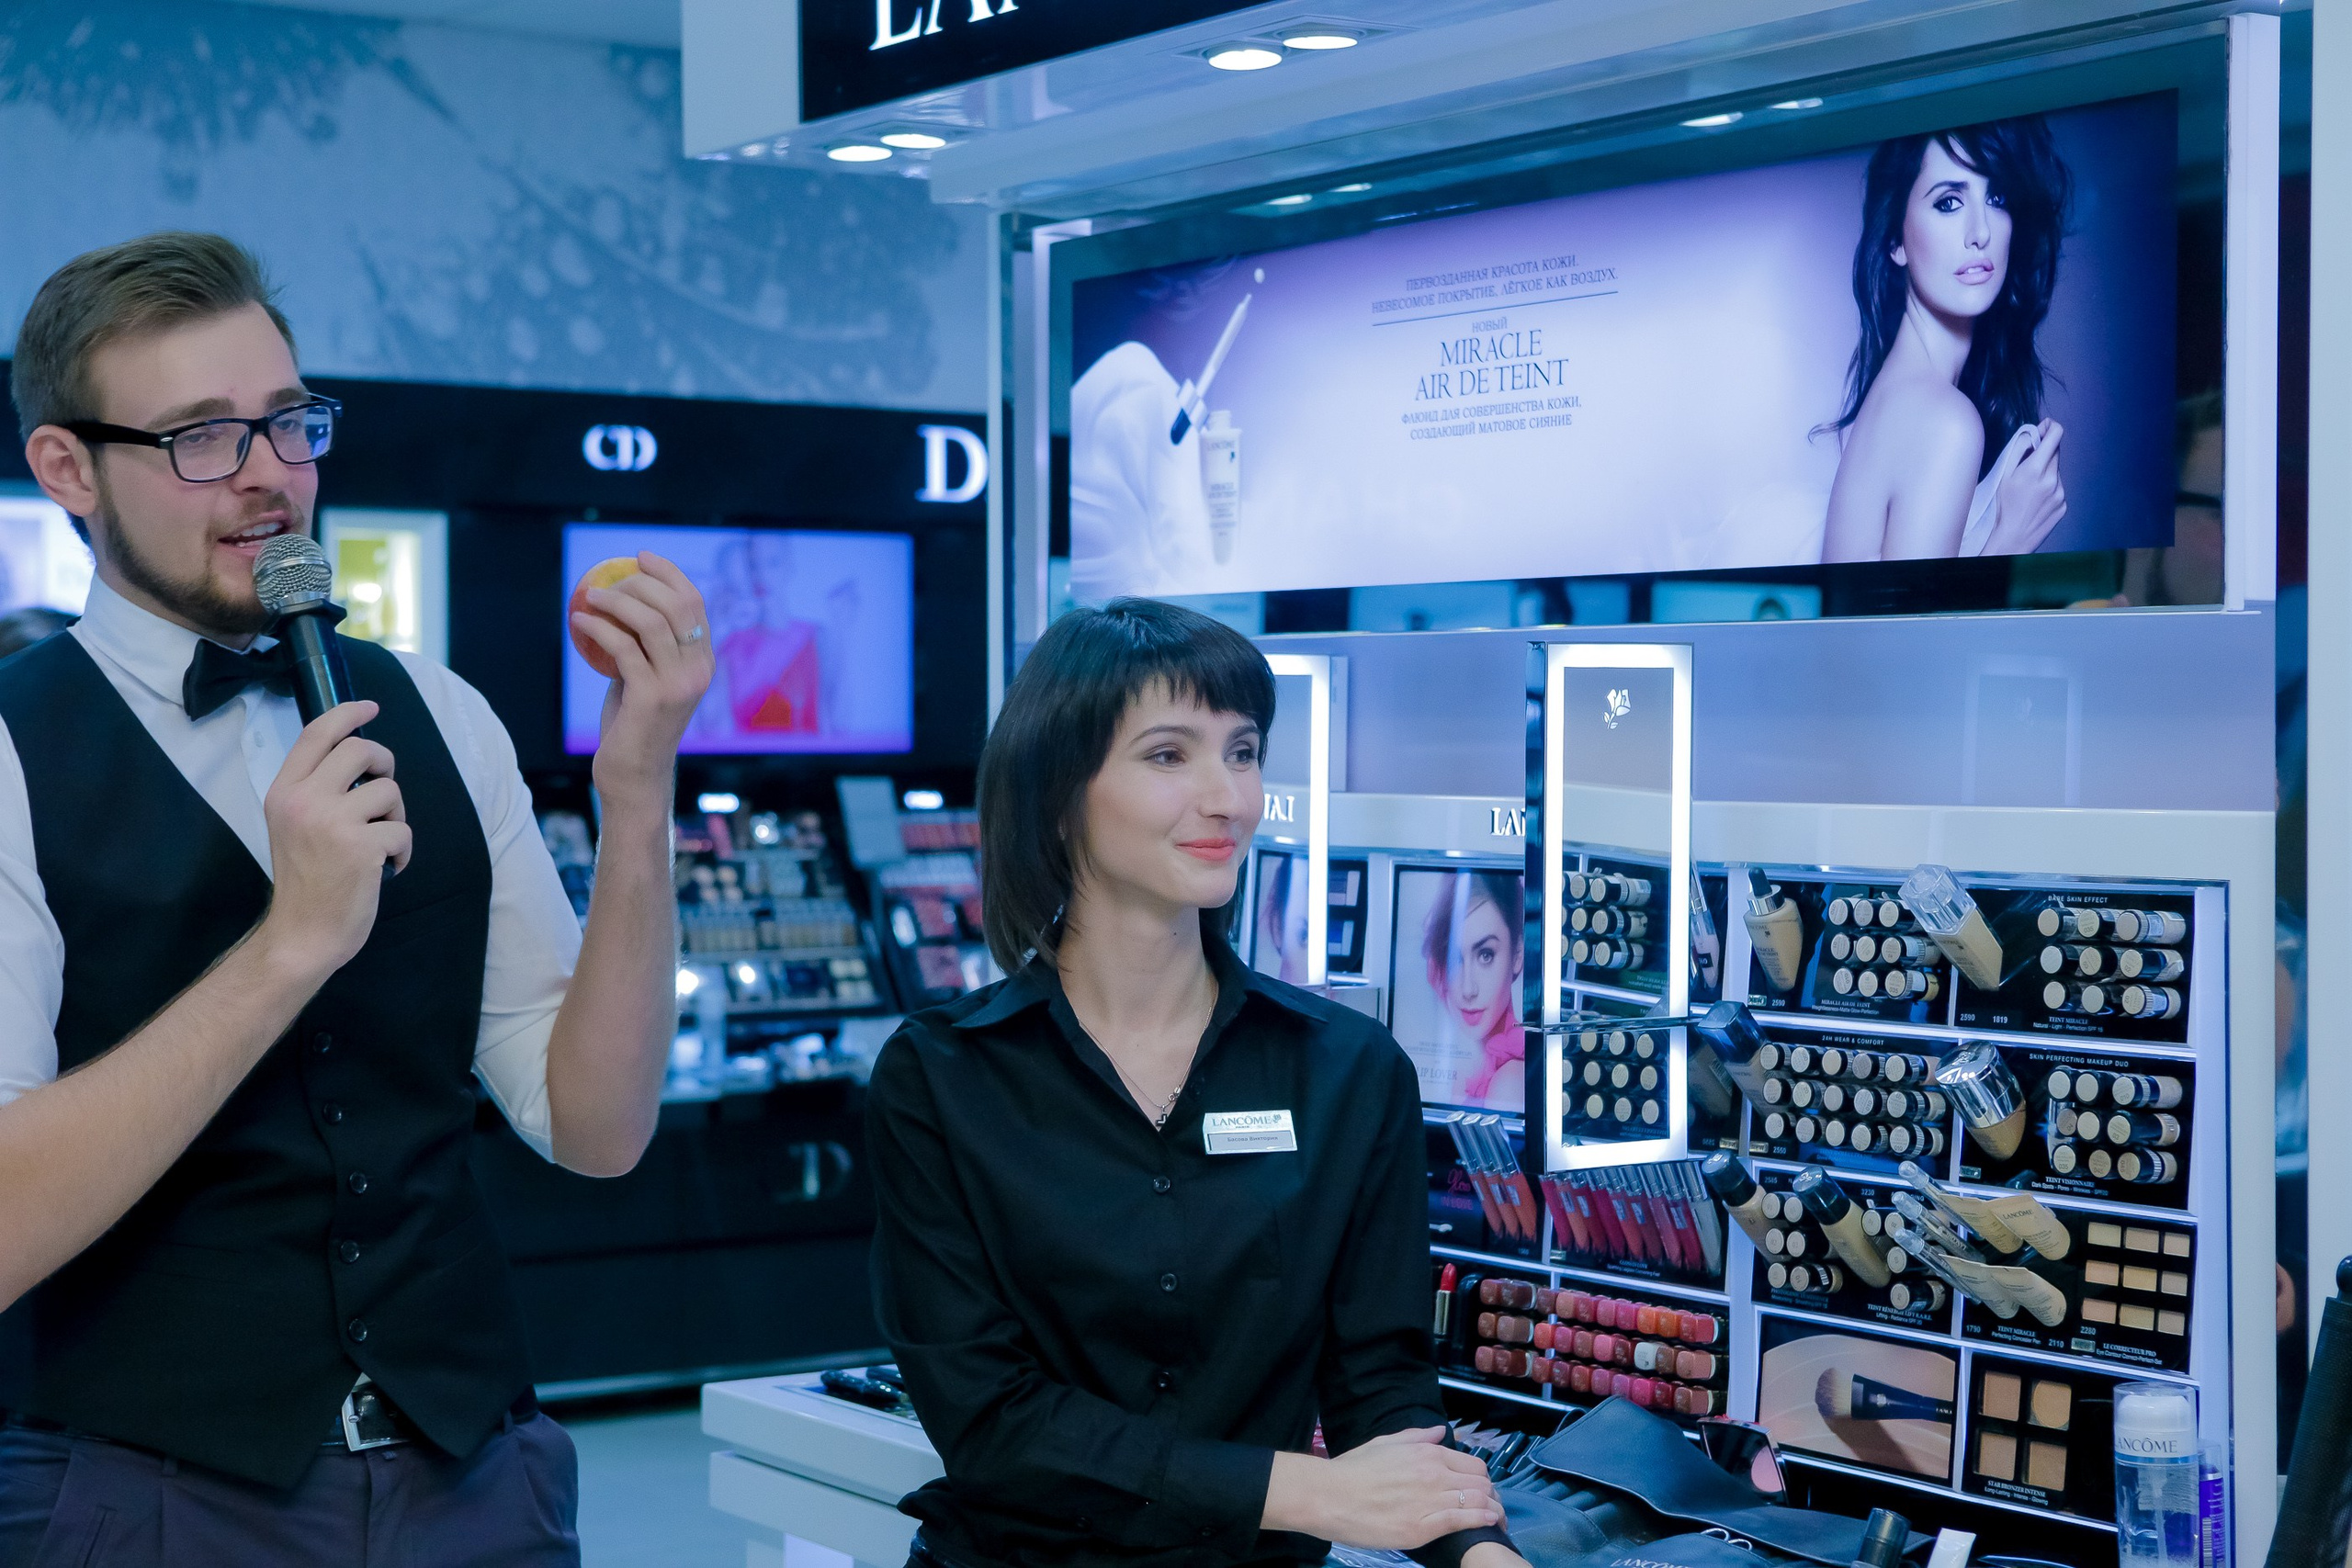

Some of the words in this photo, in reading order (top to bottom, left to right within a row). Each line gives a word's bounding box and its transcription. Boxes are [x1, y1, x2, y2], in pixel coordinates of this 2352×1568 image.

[1407, 268, 1488, 291] ПЕРВОЗДАННАЯ
[1491, 261, 1539, 278] КРАСОТА
[1542, 254, 1579, 271] КОЖИ.
[1371, 293, 1435, 314] НЕВЕСОМОЕ
[1437, 286, 1498, 305] ПОКРЫТИЕ,
[1501, 278, 1543, 296] ЛЁГКОЕ
[1545, 275, 1567, 288] КАК
[1570, 267, 1619, 286] ВОЗДУХ.
[1472, 316, 1508, 333] НОВЫЙ
[1441, 329, 1543, 367] MIRACLE
[1415, 371, 1453, 400] AIR
[1459, 367, 1490, 396] DE
[1493, 358, 1569, 393] TEINT
[1401, 410, 1439, 424] ФЛЮИД
[1440, 407, 1461, 421] ДЛЯ
[1462, 399, 1544, 419] СОВЕРШЕНСТВА
[1546, 395, 1582, 410] КОЖИ,
[1409, 421, 1476, 441] СОЗДАЮЩИЙ
[1477, 419, 1526, 434] МАТОВОЕ
[1528, 414, 1573, 430] СИЯНИЕ
[1771, 998, 1786, 1007] 2590
[1960, 1013, 1975, 1021] 2590
[1992, 1015, 2008, 1024] 1819
[2065, 1017, 2088, 1025] MIRACLE
[1834, 1035, 1850, 1043] WEAR
[1857, 1038, 1884, 1046] COMFORT
[2029, 1053, 2045, 1061] SKIN
[2045, 1054, 2085, 1064] PERFECTING
[2086, 1056, 2113, 1066] MAKEUP
[2114, 1060, 2130, 1068] DUO
[1430, 1067, 1458, 1081] LOVER
[1212, 1115, 1272, 1127] LANCÔME
[1773, 1145, 1787, 1155] 2550
[2041, 1182, 2054, 1190] Spots
[2045, 1176, 2062, 1184] TEINT
[2061, 1179, 2096, 1188] VISIONNAIRE
[1867, 1303, 1882, 1312] TEINT
[1875, 1312, 1888, 1320] Lifting
[1890, 1314, 1908, 1323] Radiance
[1966, 1324, 1982, 1334] 1790
[1997, 1325, 2013, 1333] TEINT
[2013, 1327, 2036, 1337] MIRACLE
[2080, 1325, 2097, 1336] 2280
[1991, 1331, 2012, 1341] Perfecting
[2048, 1337, 2064, 1348] 2110
[2096, 1348, 2105, 1357] Eye
[2104, 1349, 2122, 1358] Contour
[2109, 1344, 2145, 1355] CORRECTEUR
[2144, 1349, 2157, 1358] PRO
[2116, 1437, 2177, 1453] ANCÔME
[1987, 1480, 2001, 1489] STAR
[2000, 1483, 2025, 1494] BRONZER
[2024, 1487, 2046, 1498] INTENSE
[1984, 1486, 2011, 1498] Long-Lasting
[2013, 1492, 2029, 1501] Intense
[2030, 1495, 2049, 1506] Glowing
